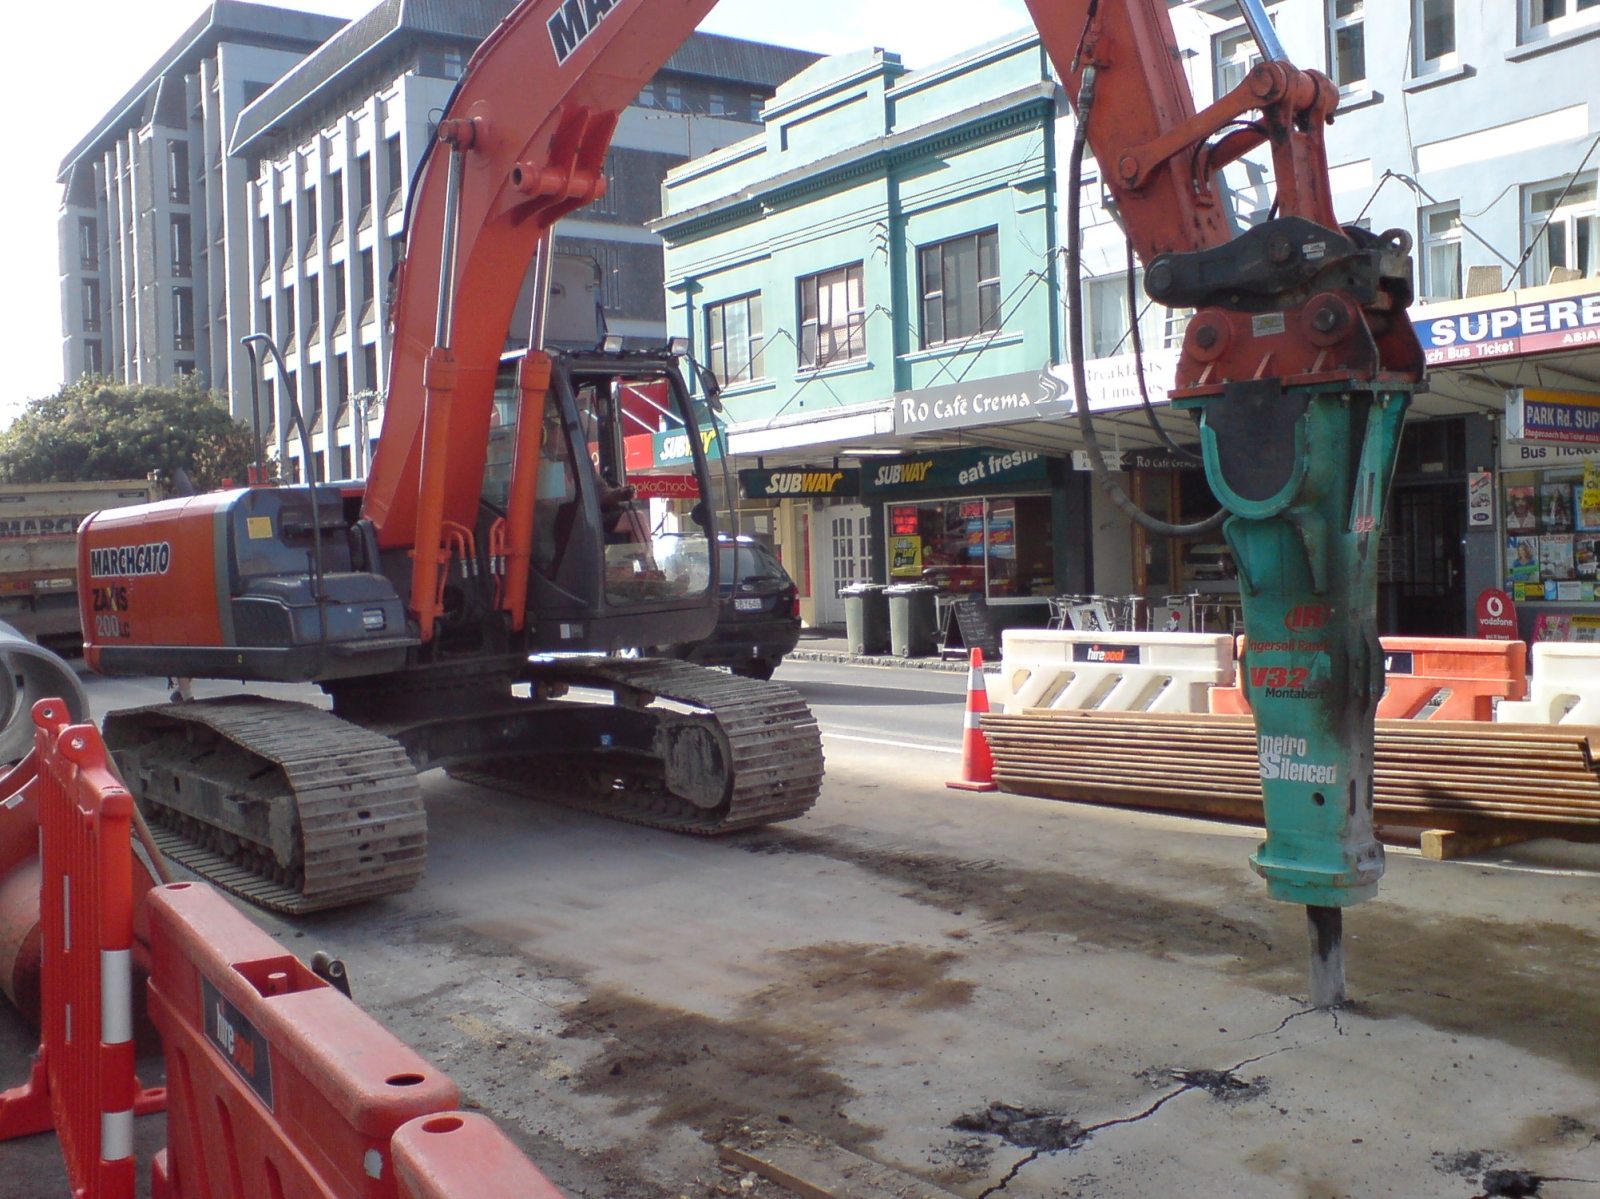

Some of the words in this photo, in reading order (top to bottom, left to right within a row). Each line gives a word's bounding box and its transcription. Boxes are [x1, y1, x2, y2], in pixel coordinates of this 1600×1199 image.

[1448, 346, 1470, 359] Bus
[1476, 340, 1514, 355] Ticket
[901, 398, 929, 424] Ro
[972, 392, 1030, 413] Crema
[1526, 405, 1554, 426] PARK
[1557, 408, 1573, 427] Rd.
[1521, 446, 1546, 459] Bus
[765, 472, 844, 494] SUBWAY
[875, 460, 933, 486] SUBWAY
[958, 461, 986, 485] eat
[90, 541, 170, 577] MARCHCATO
[92, 585, 128, 611] ZAXIS
[1480, 618, 1512, 627] vodafone
[1087, 645, 1125, 662] hirepool
[1250, 667, 1309, 689] V32
[1265, 687, 1324, 700] Montabert
[1261, 734, 1306, 757] metro
[1260, 753, 1337, 784] Silenced
